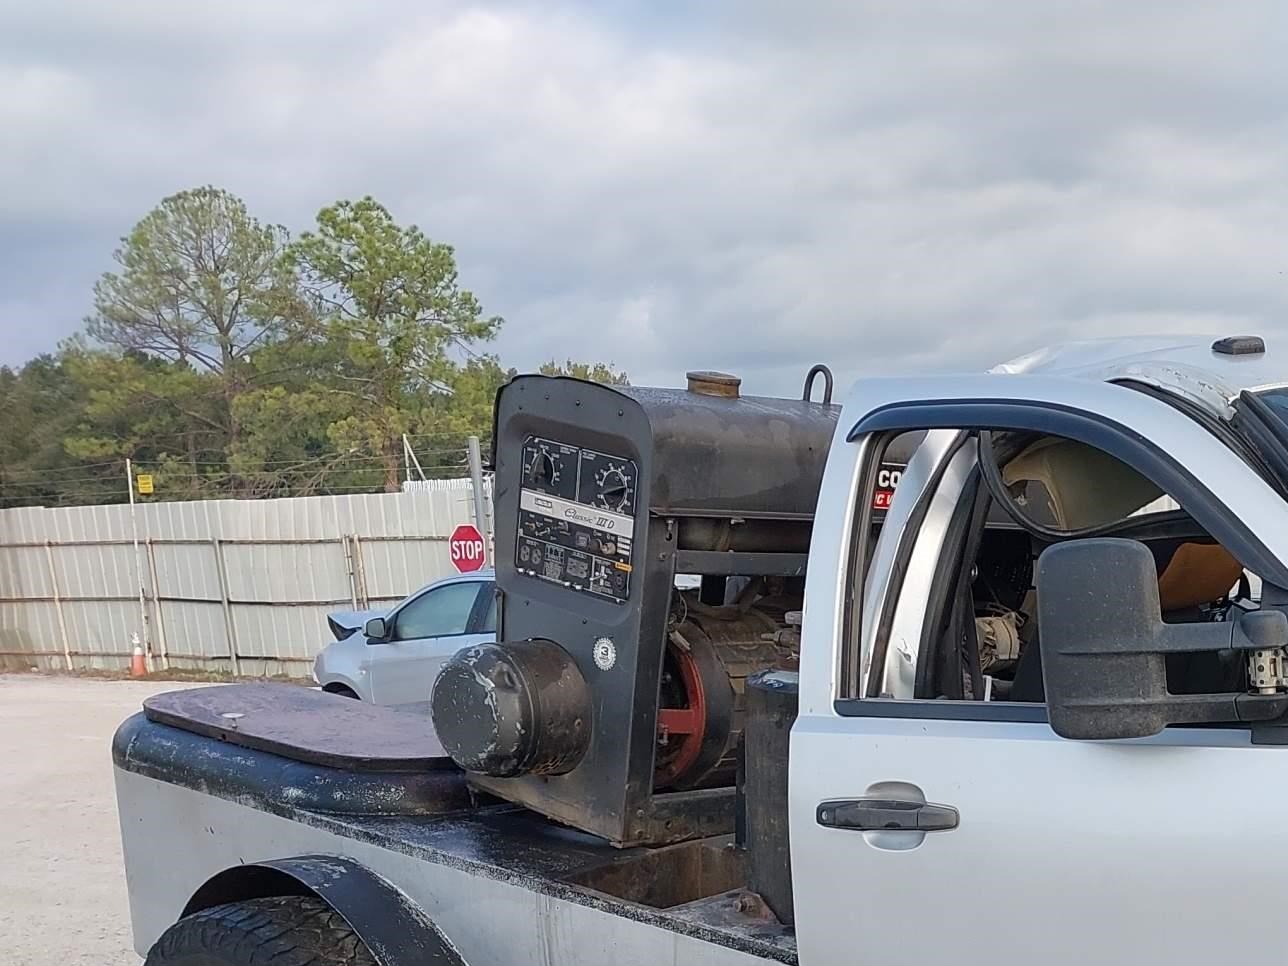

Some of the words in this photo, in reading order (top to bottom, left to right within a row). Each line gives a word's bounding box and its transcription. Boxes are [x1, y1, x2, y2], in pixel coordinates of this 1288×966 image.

[879, 470, 902, 488] CO
[452, 540, 482, 560] STOP
[601, 646, 609, 656] 3
